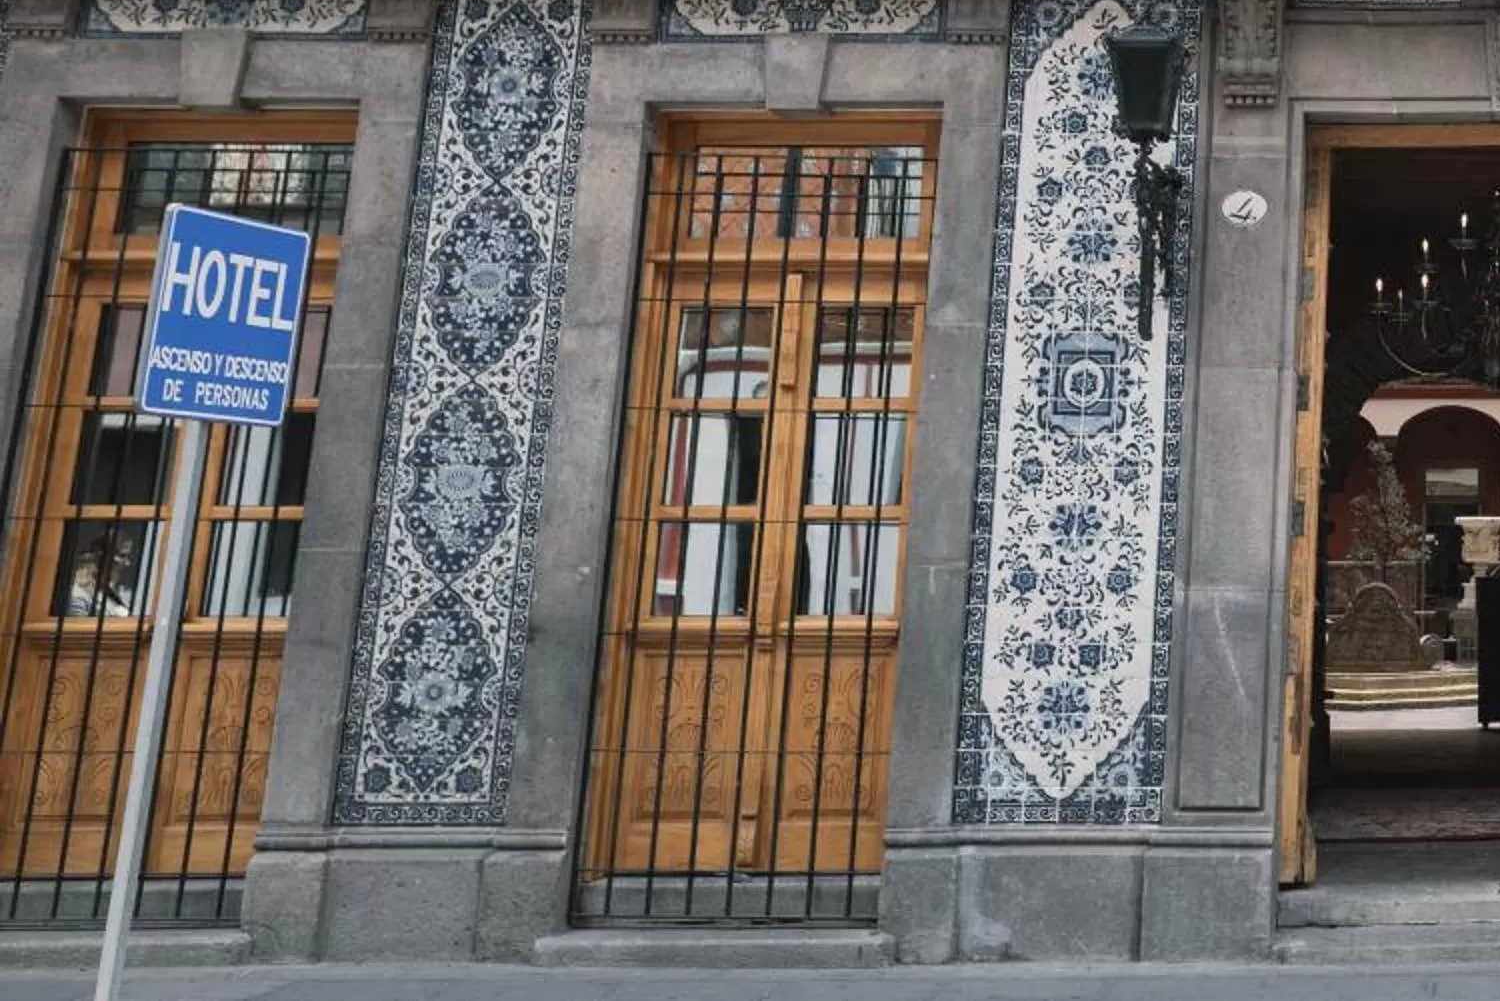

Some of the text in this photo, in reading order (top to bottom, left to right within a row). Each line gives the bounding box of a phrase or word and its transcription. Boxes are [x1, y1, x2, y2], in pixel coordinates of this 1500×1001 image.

[161, 241, 293, 331] HOTEL
[150, 345, 287, 383] ASCENSO Y DESCENSO
[163, 378, 270, 411] DE PERSONAS
